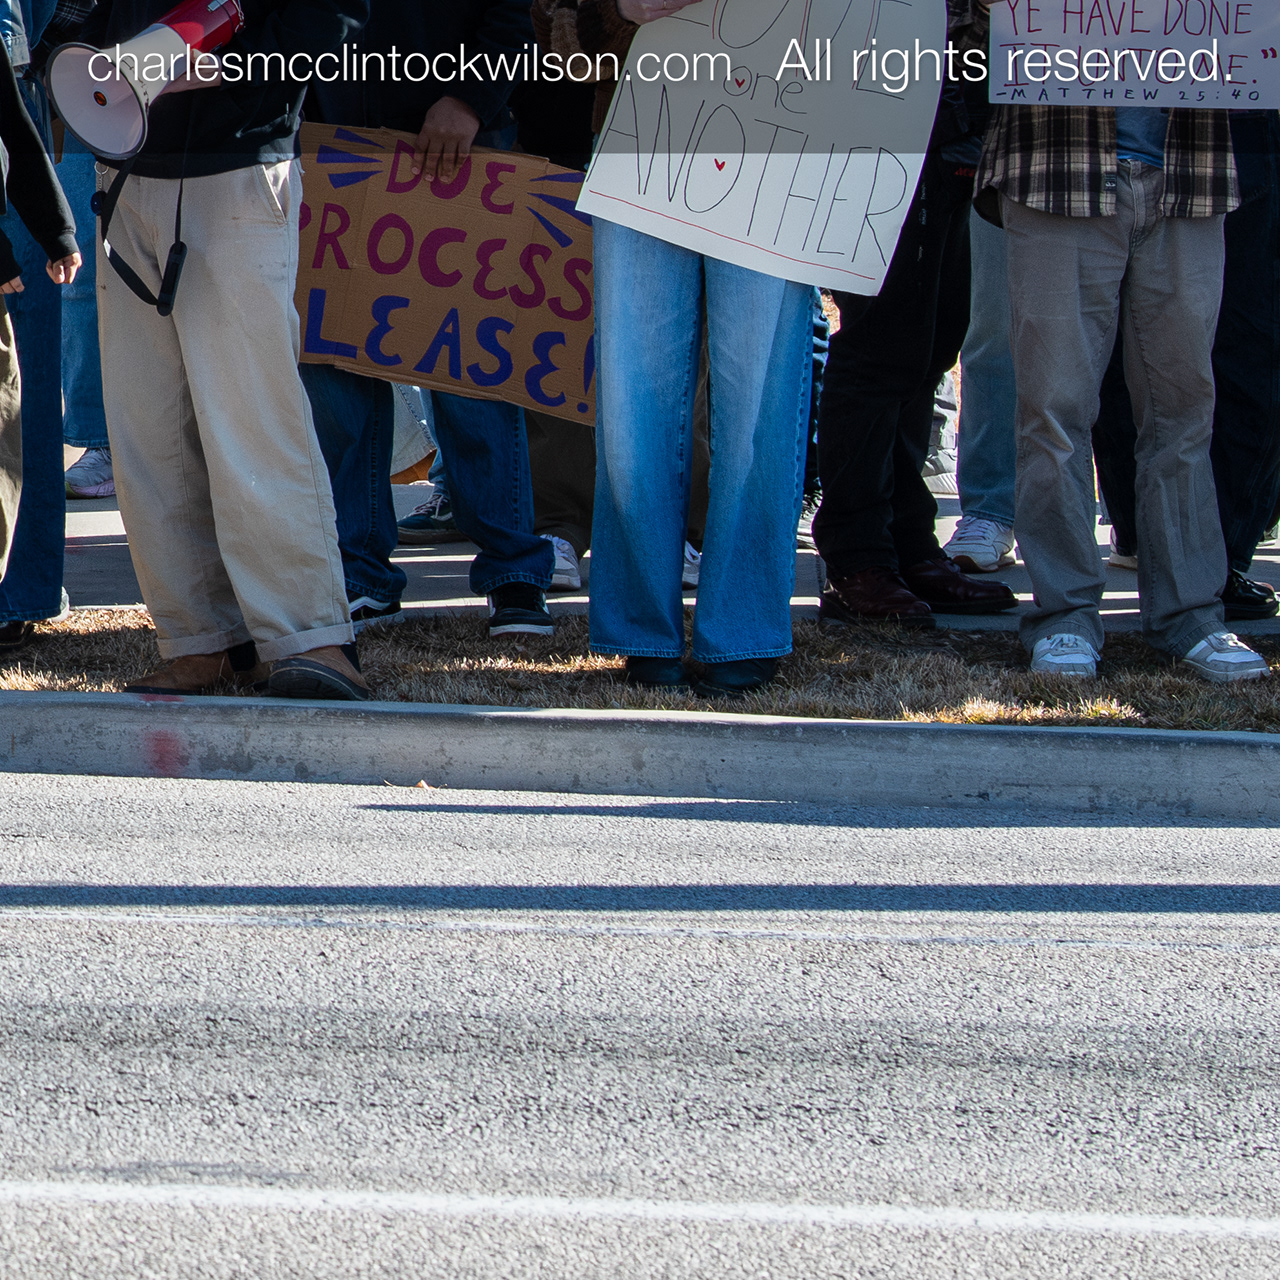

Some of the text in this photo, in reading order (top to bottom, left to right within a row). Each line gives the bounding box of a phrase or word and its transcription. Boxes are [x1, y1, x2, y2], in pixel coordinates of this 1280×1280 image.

[722, 65, 808, 115] one
[1000, 43, 1061, 87] IT
[1078, 45, 1178, 86] UNTO
[386, 138, 517, 215] DUE
[585, 69, 908, 268] ANOTHER
[304, 288, 595, 413] LEASE!
